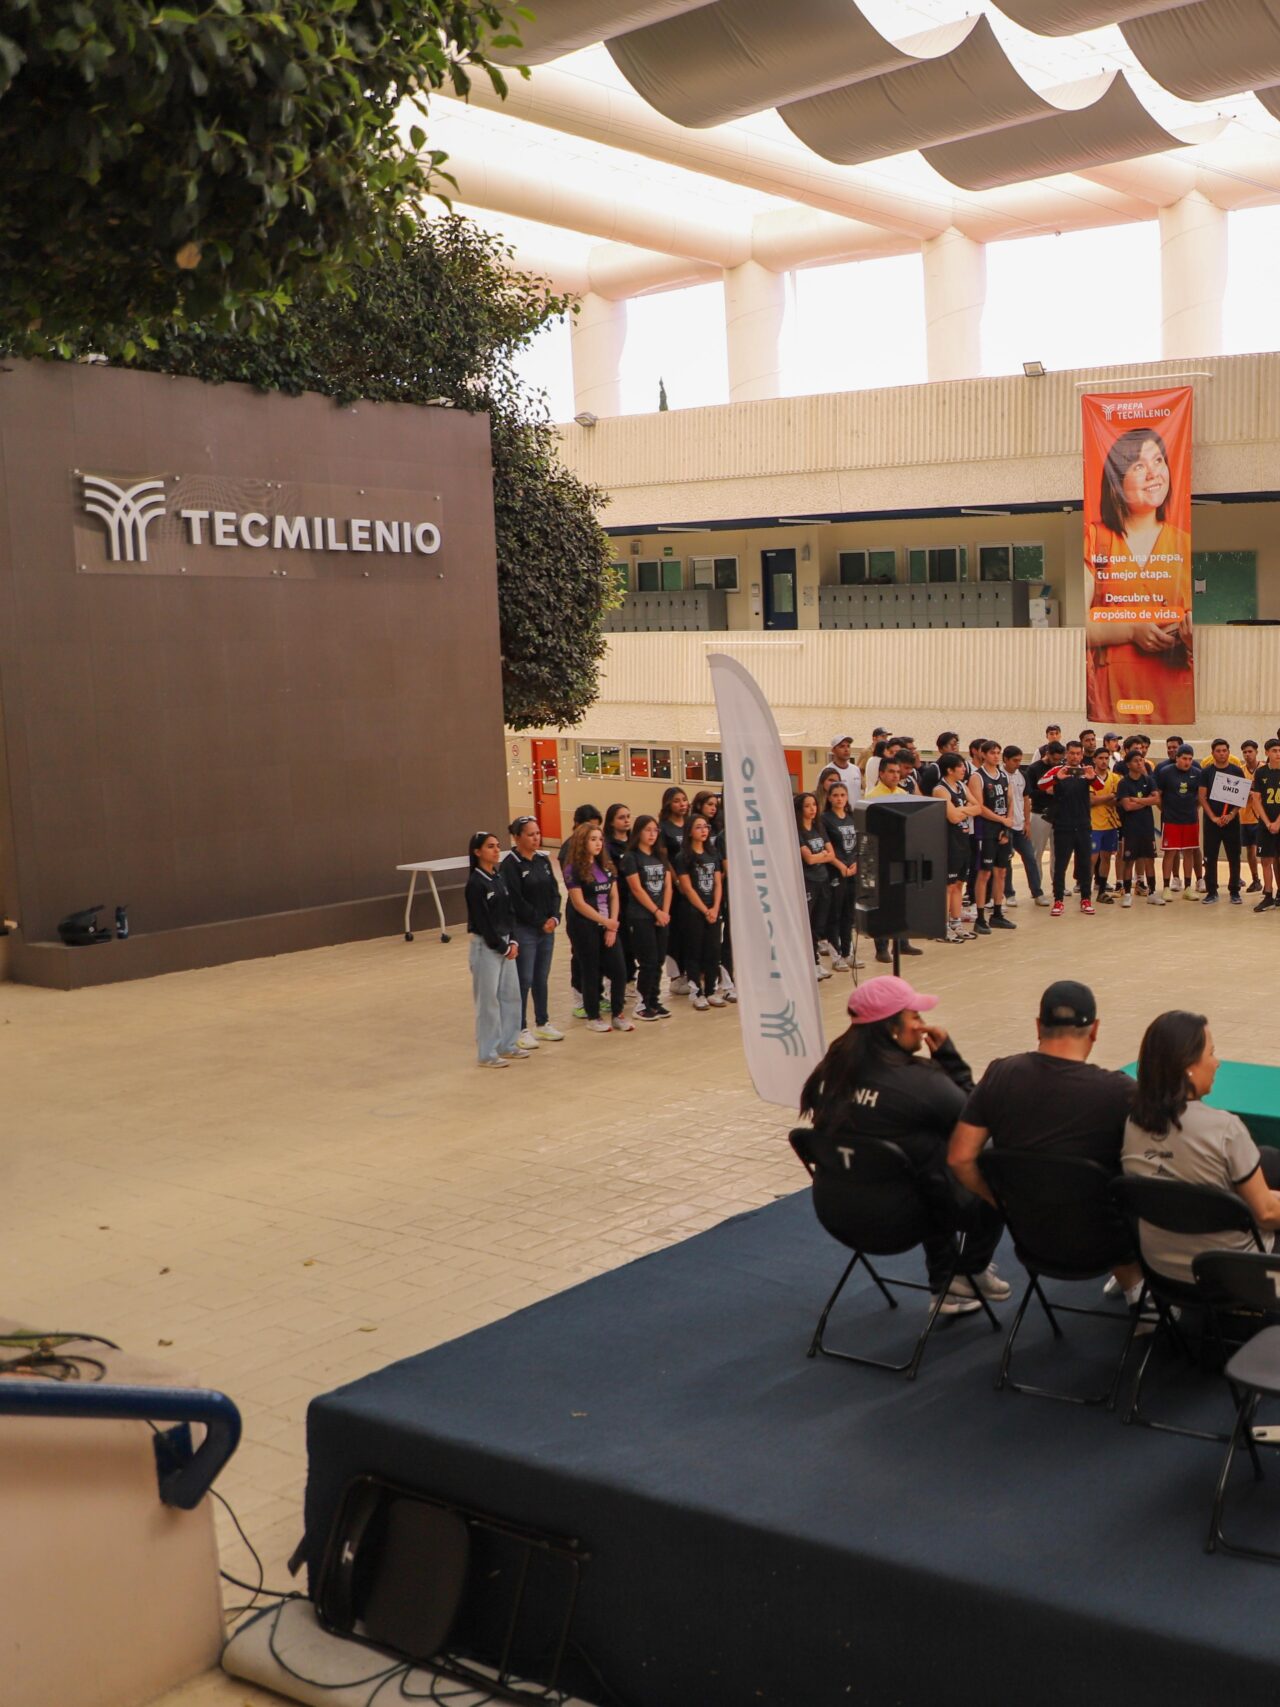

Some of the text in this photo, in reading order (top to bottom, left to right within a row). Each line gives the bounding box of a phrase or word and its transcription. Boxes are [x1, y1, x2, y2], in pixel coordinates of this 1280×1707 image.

[1117, 402, 1143, 411] PREPA
[1117, 408, 1171, 420] TECMILENIO
[180, 509, 441, 554] TECMILENIO
[1109, 554, 1127, 564] que
[1149, 553, 1184, 564] prepa,
[1097, 570, 1172, 581] tu mejor etapa.
[1105, 593, 1164, 603] Descubre tu
[1093, 609, 1180, 621] propósito de vida.
[1222, 784, 1240, 794] UNID
[837, 1146, 855, 1170] T
